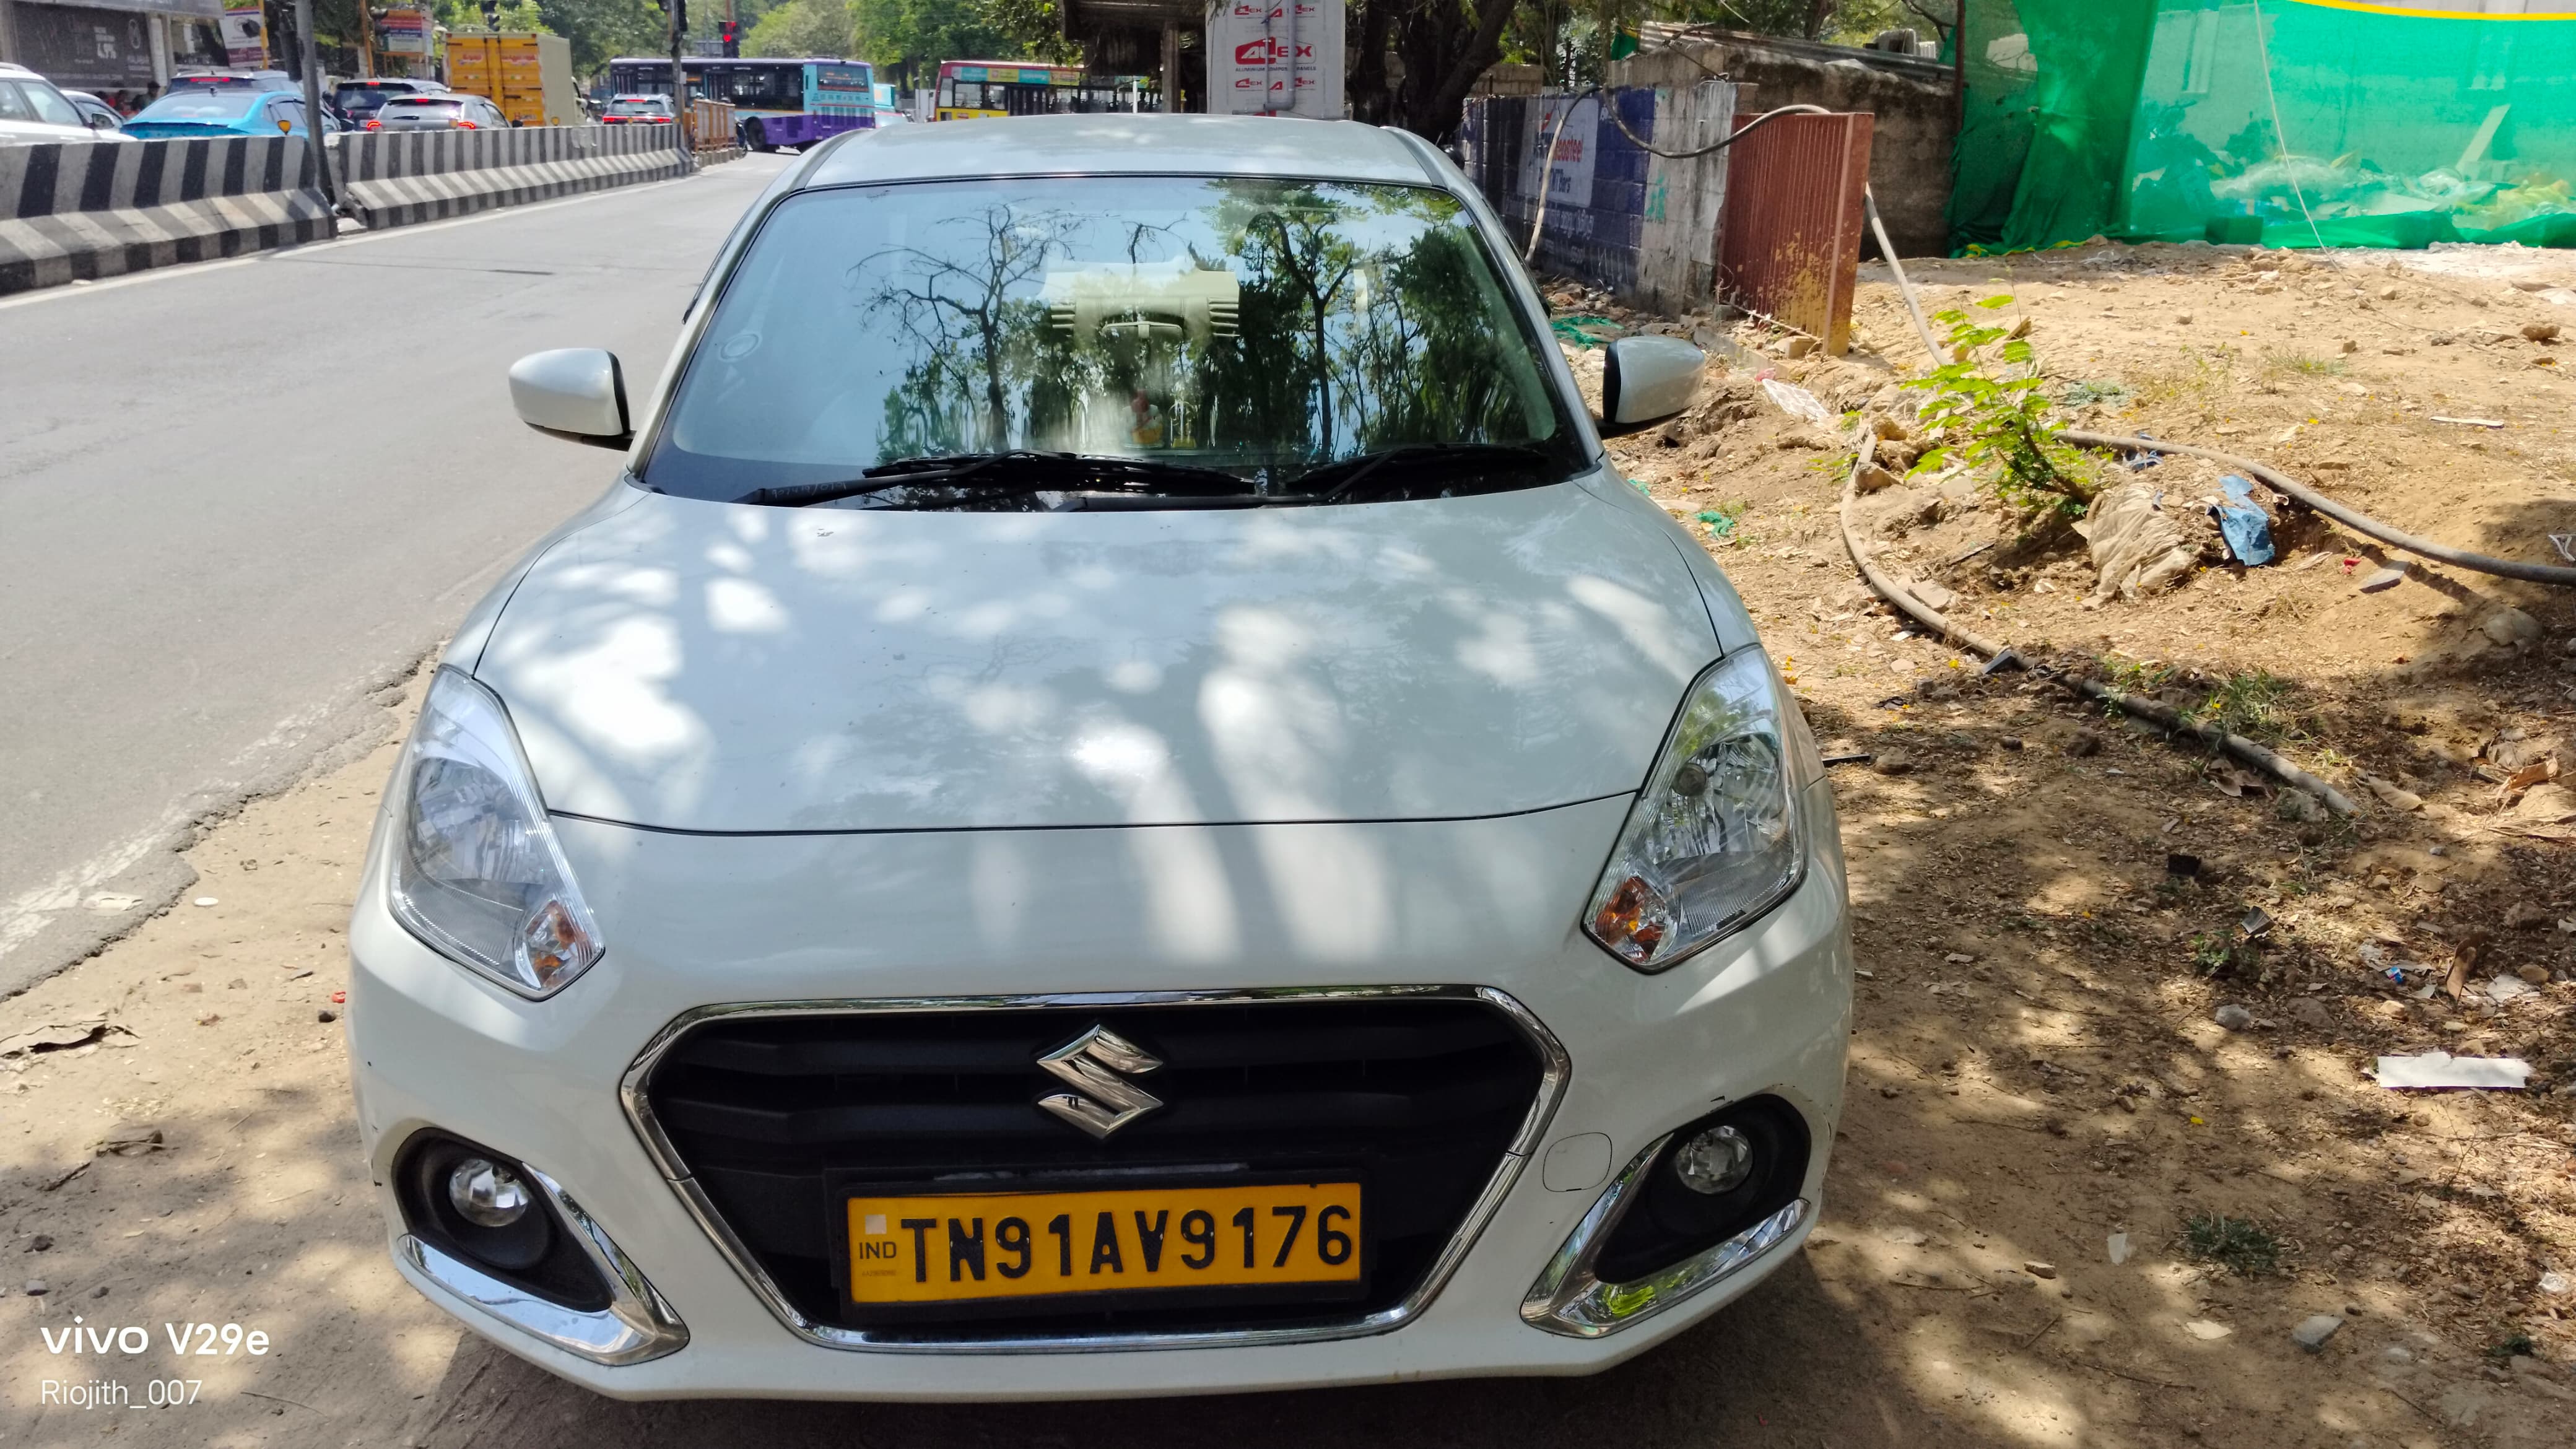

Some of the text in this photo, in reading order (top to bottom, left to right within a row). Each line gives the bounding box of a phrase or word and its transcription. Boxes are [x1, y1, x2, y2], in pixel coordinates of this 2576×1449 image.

[1238, 43, 1313, 61] ALEX
[859, 1242, 897, 1259] IND
[900, 1204, 1352, 1282] TN91AV9176
